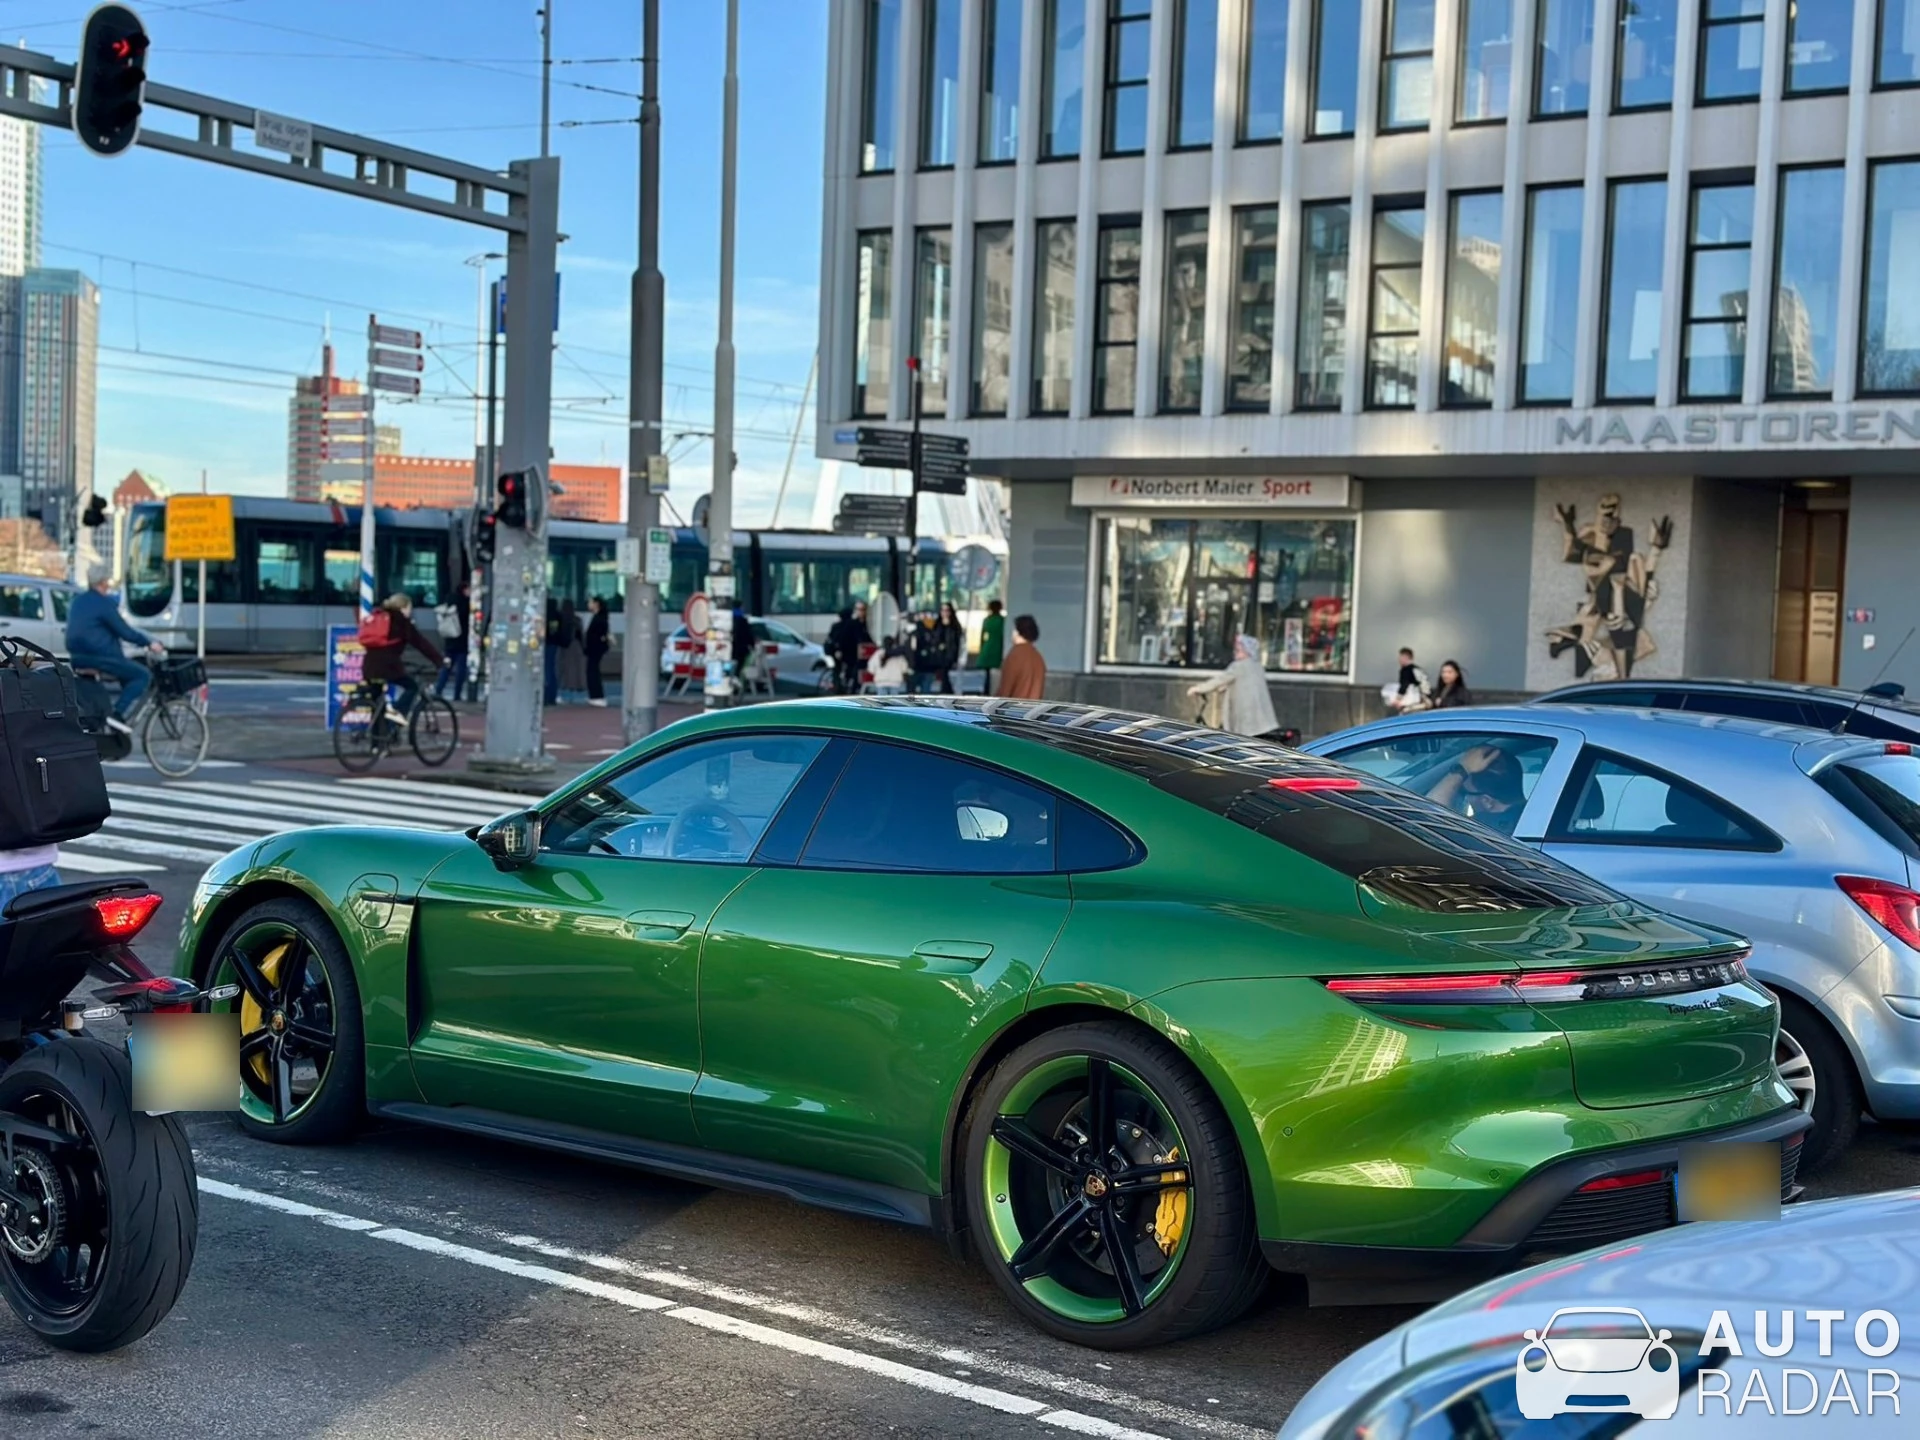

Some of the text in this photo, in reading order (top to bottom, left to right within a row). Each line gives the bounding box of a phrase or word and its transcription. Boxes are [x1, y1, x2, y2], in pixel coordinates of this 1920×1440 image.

[1131, 478, 1312, 499] Norbert Maier Sport
[1617, 963, 1733, 988] PORSCHE
